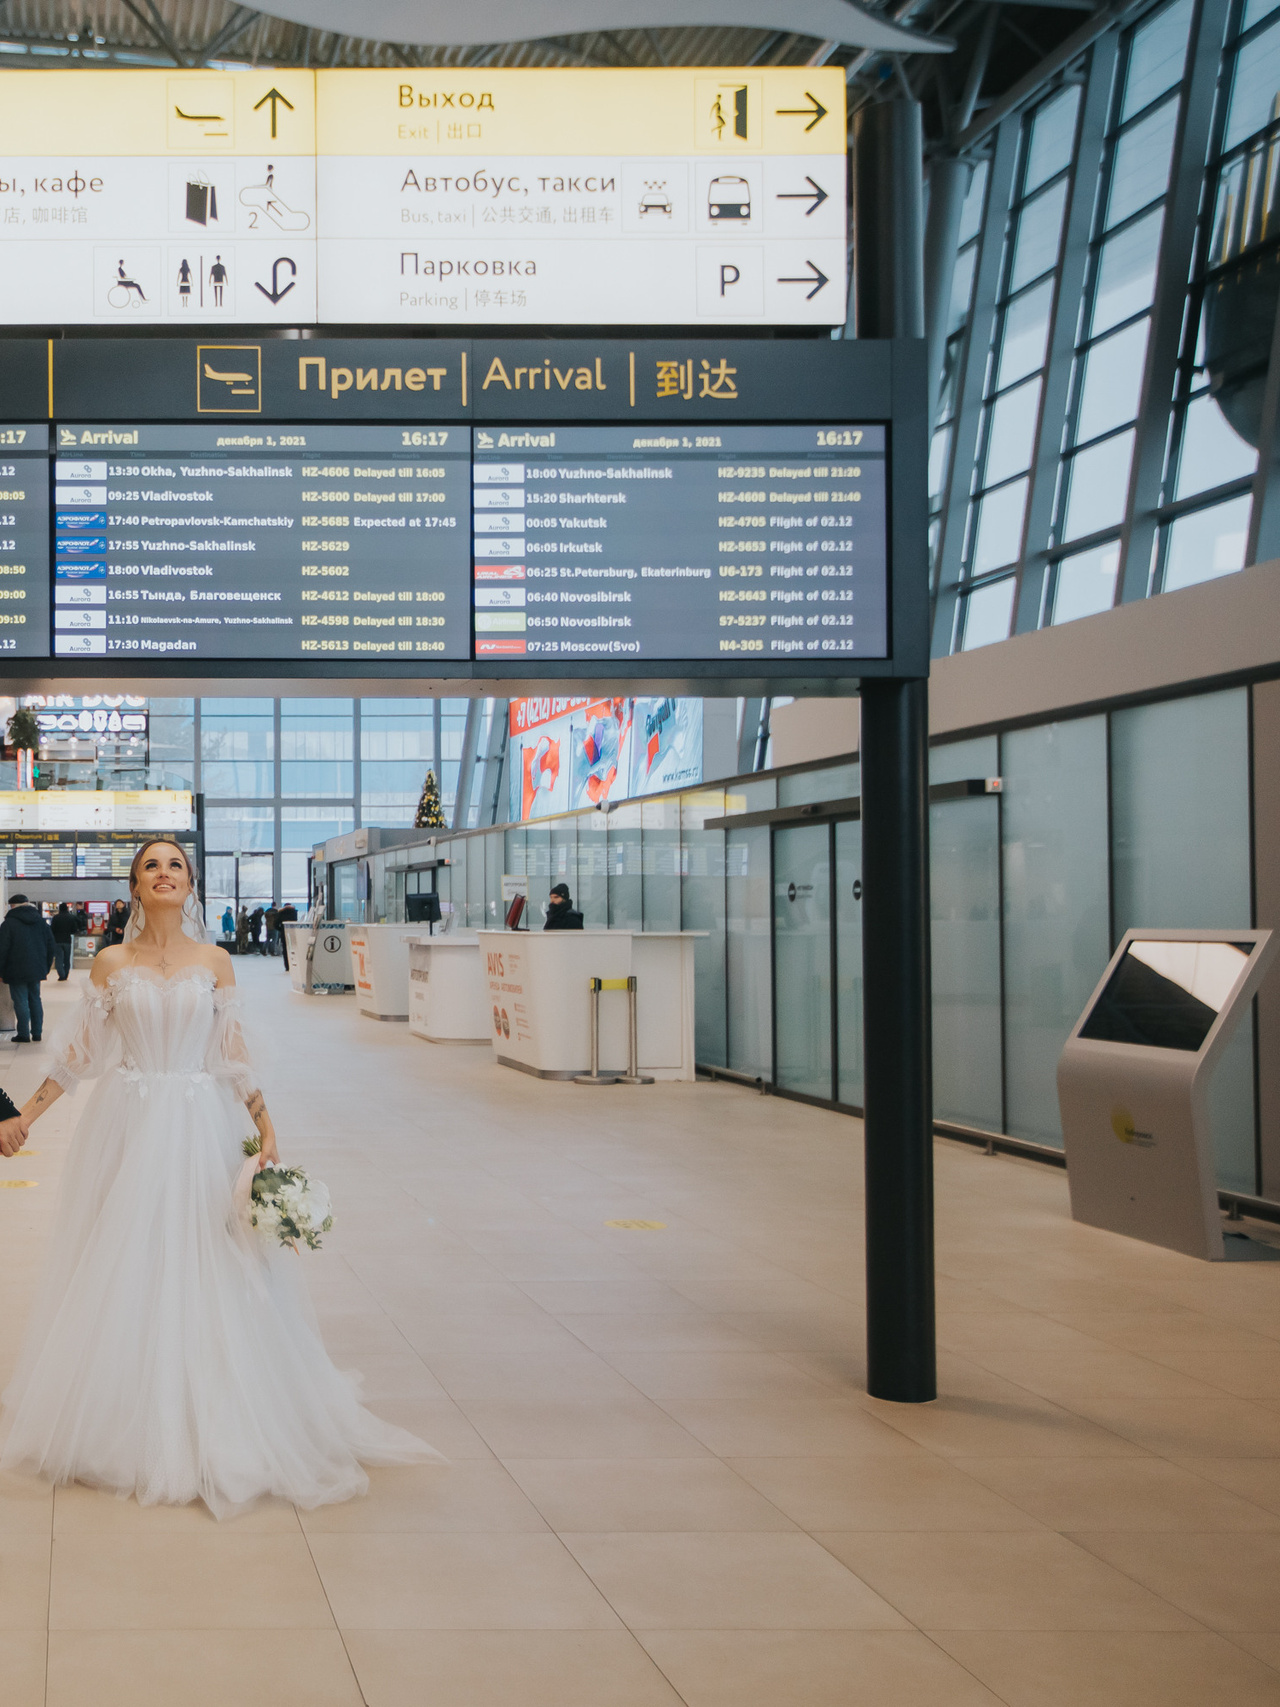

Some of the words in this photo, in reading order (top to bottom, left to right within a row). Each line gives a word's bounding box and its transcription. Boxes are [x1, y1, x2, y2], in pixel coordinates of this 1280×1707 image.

[398, 84, 495, 111] Выход
[397, 124, 429, 140] Exit
[446, 122, 483, 140] 出口
[34, 170, 105, 199] кафе
[400, 168, 529, 197] Автобус,
[538, 175, 615, 192] такси
[32, 206, 88, 224] 咖啡馆
[248, 212, 259, 230] 2
[400, 208, 435, 225] Bus,
[437, 208, 467, 224] taxi
[562, 206, 615, 224] 出租车
[400, 252, 537, 281] Парковка
[400, 291, 458, 310] Parking
[475, 289, 527, 307] 停车场
[298, 357, 446, 399] Прилет
[482, 356, 607, 391] Arrival
[655, 359, 739, 401] 到达
[81, 430, 139, 445] Arrival
[216, 436, 263, 448] декабря
[266, 436, 277, 447] 1,
[279, 435, 306, 446] 2021
[402, 431, 449, 446] 16:17
[498, 433, 556, 448] Arrival
[632, 437, 680, 449] декабря
[695, 437, 722, 448] 2021
[816, 431, 864, 446] 16:17
[108, 491, 139, 501] 09:25
[141, 490, 213, 501] Vladivostok
[302, 491, 350, 502] HZ-5600
[353, 492, 396, 504] Delayed
[398, 492, 413, 502] till
[416, 493, 446, 502] 17:00
[108, 516, 139, 526] 17:40
[141, 515, 294, 528] Petropavlovsk-Kamchatskiy
[302, 516, 350, 526] HZ-5685
[353, 517, 406, 528] Expected
[409, 518, 421, 527] at
[425, 517, 457, 527] 17:45
[526, 567, 558, 578] 06:25
[559, 567, 638, 579] St.Petersburg,
[641, 567, 711, 579] Ekaterinburg
[719, 566, 763, 577] U6-173
[770, 566, 804, 578] Flight
[806, 565, 819, 576] of
[821, 566, 853, 576] 02.12
[108, 590, 139, 600] 16:55
[141, 590, 185, 602] Тында,
[189, 590, 282, 602] Благовещенск
[301, 590, 350, 601] HZ-4612
[353, 591, 395, 603] Delayed
[398, 592, 413, 601] till
[415, 592, 445, 601] 18:00
[487, 953, 504, 977] AVIS
